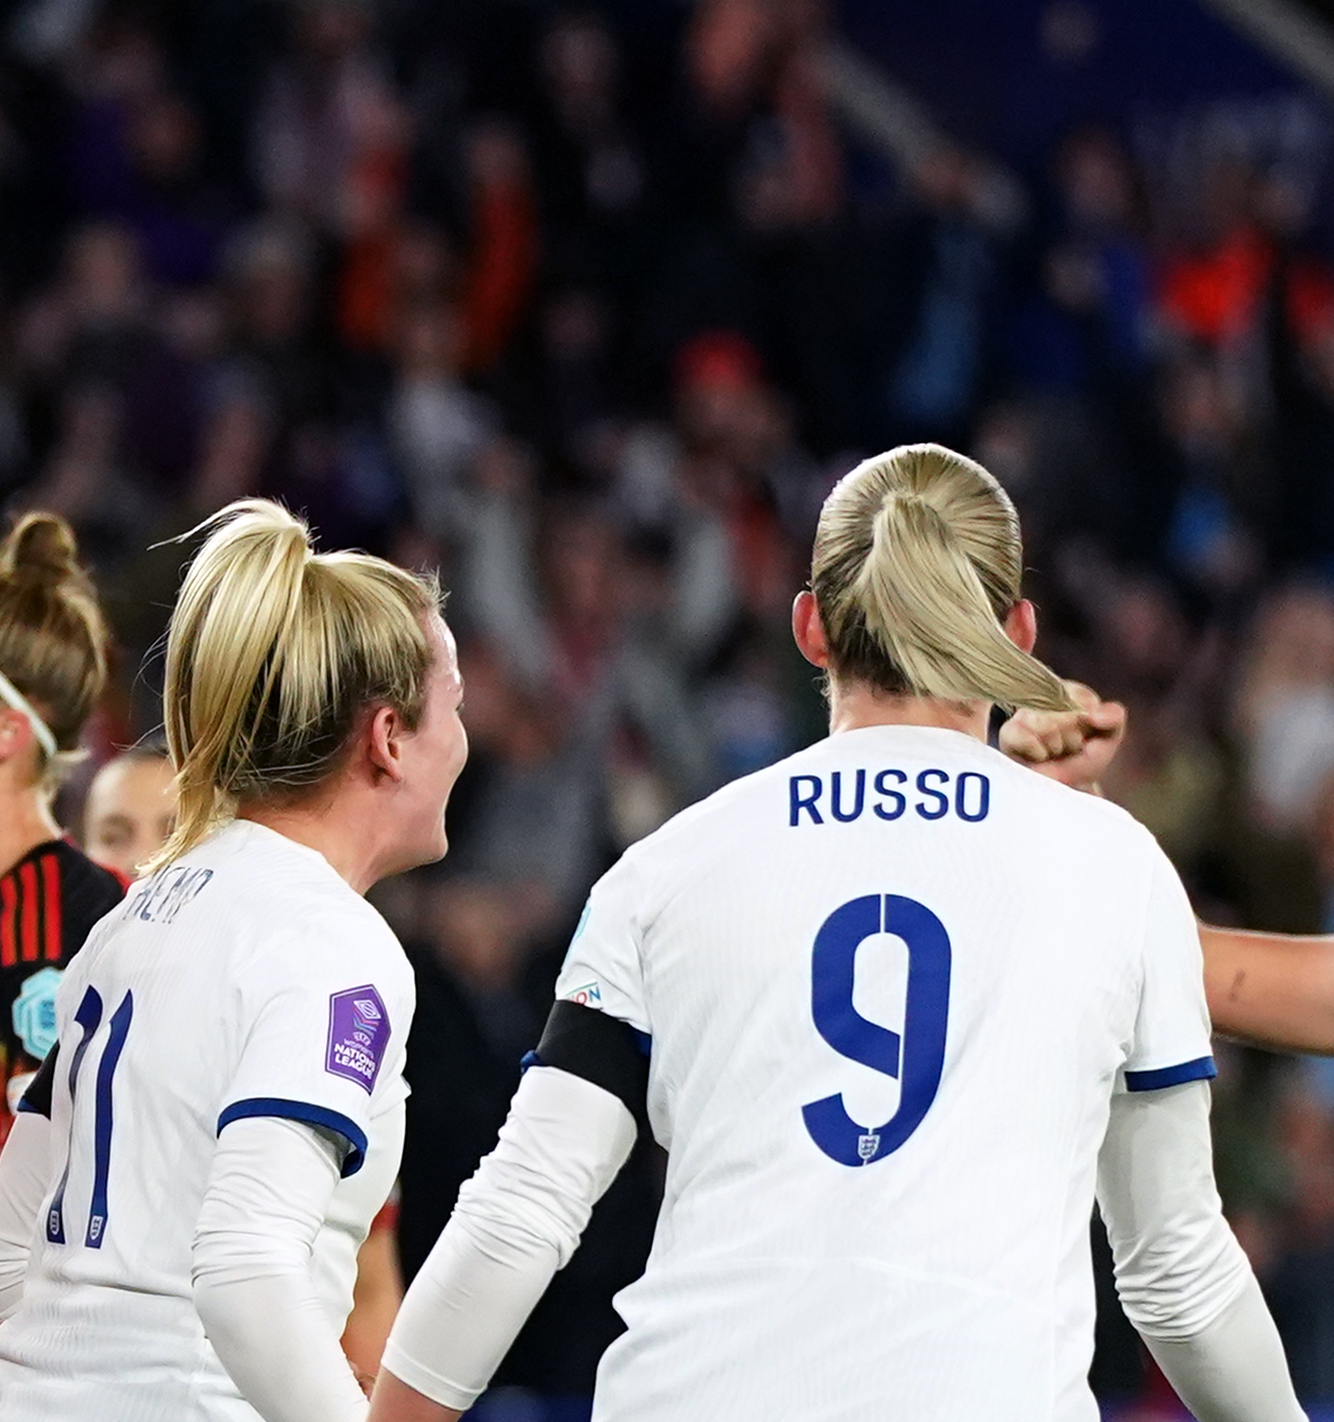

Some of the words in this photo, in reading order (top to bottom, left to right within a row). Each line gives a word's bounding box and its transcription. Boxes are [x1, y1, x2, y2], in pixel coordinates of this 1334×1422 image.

[788, 768, 990, 828] RUSSO
[48, 984, 134, 1249] 11
[801, 893, 952, 1167] 9
